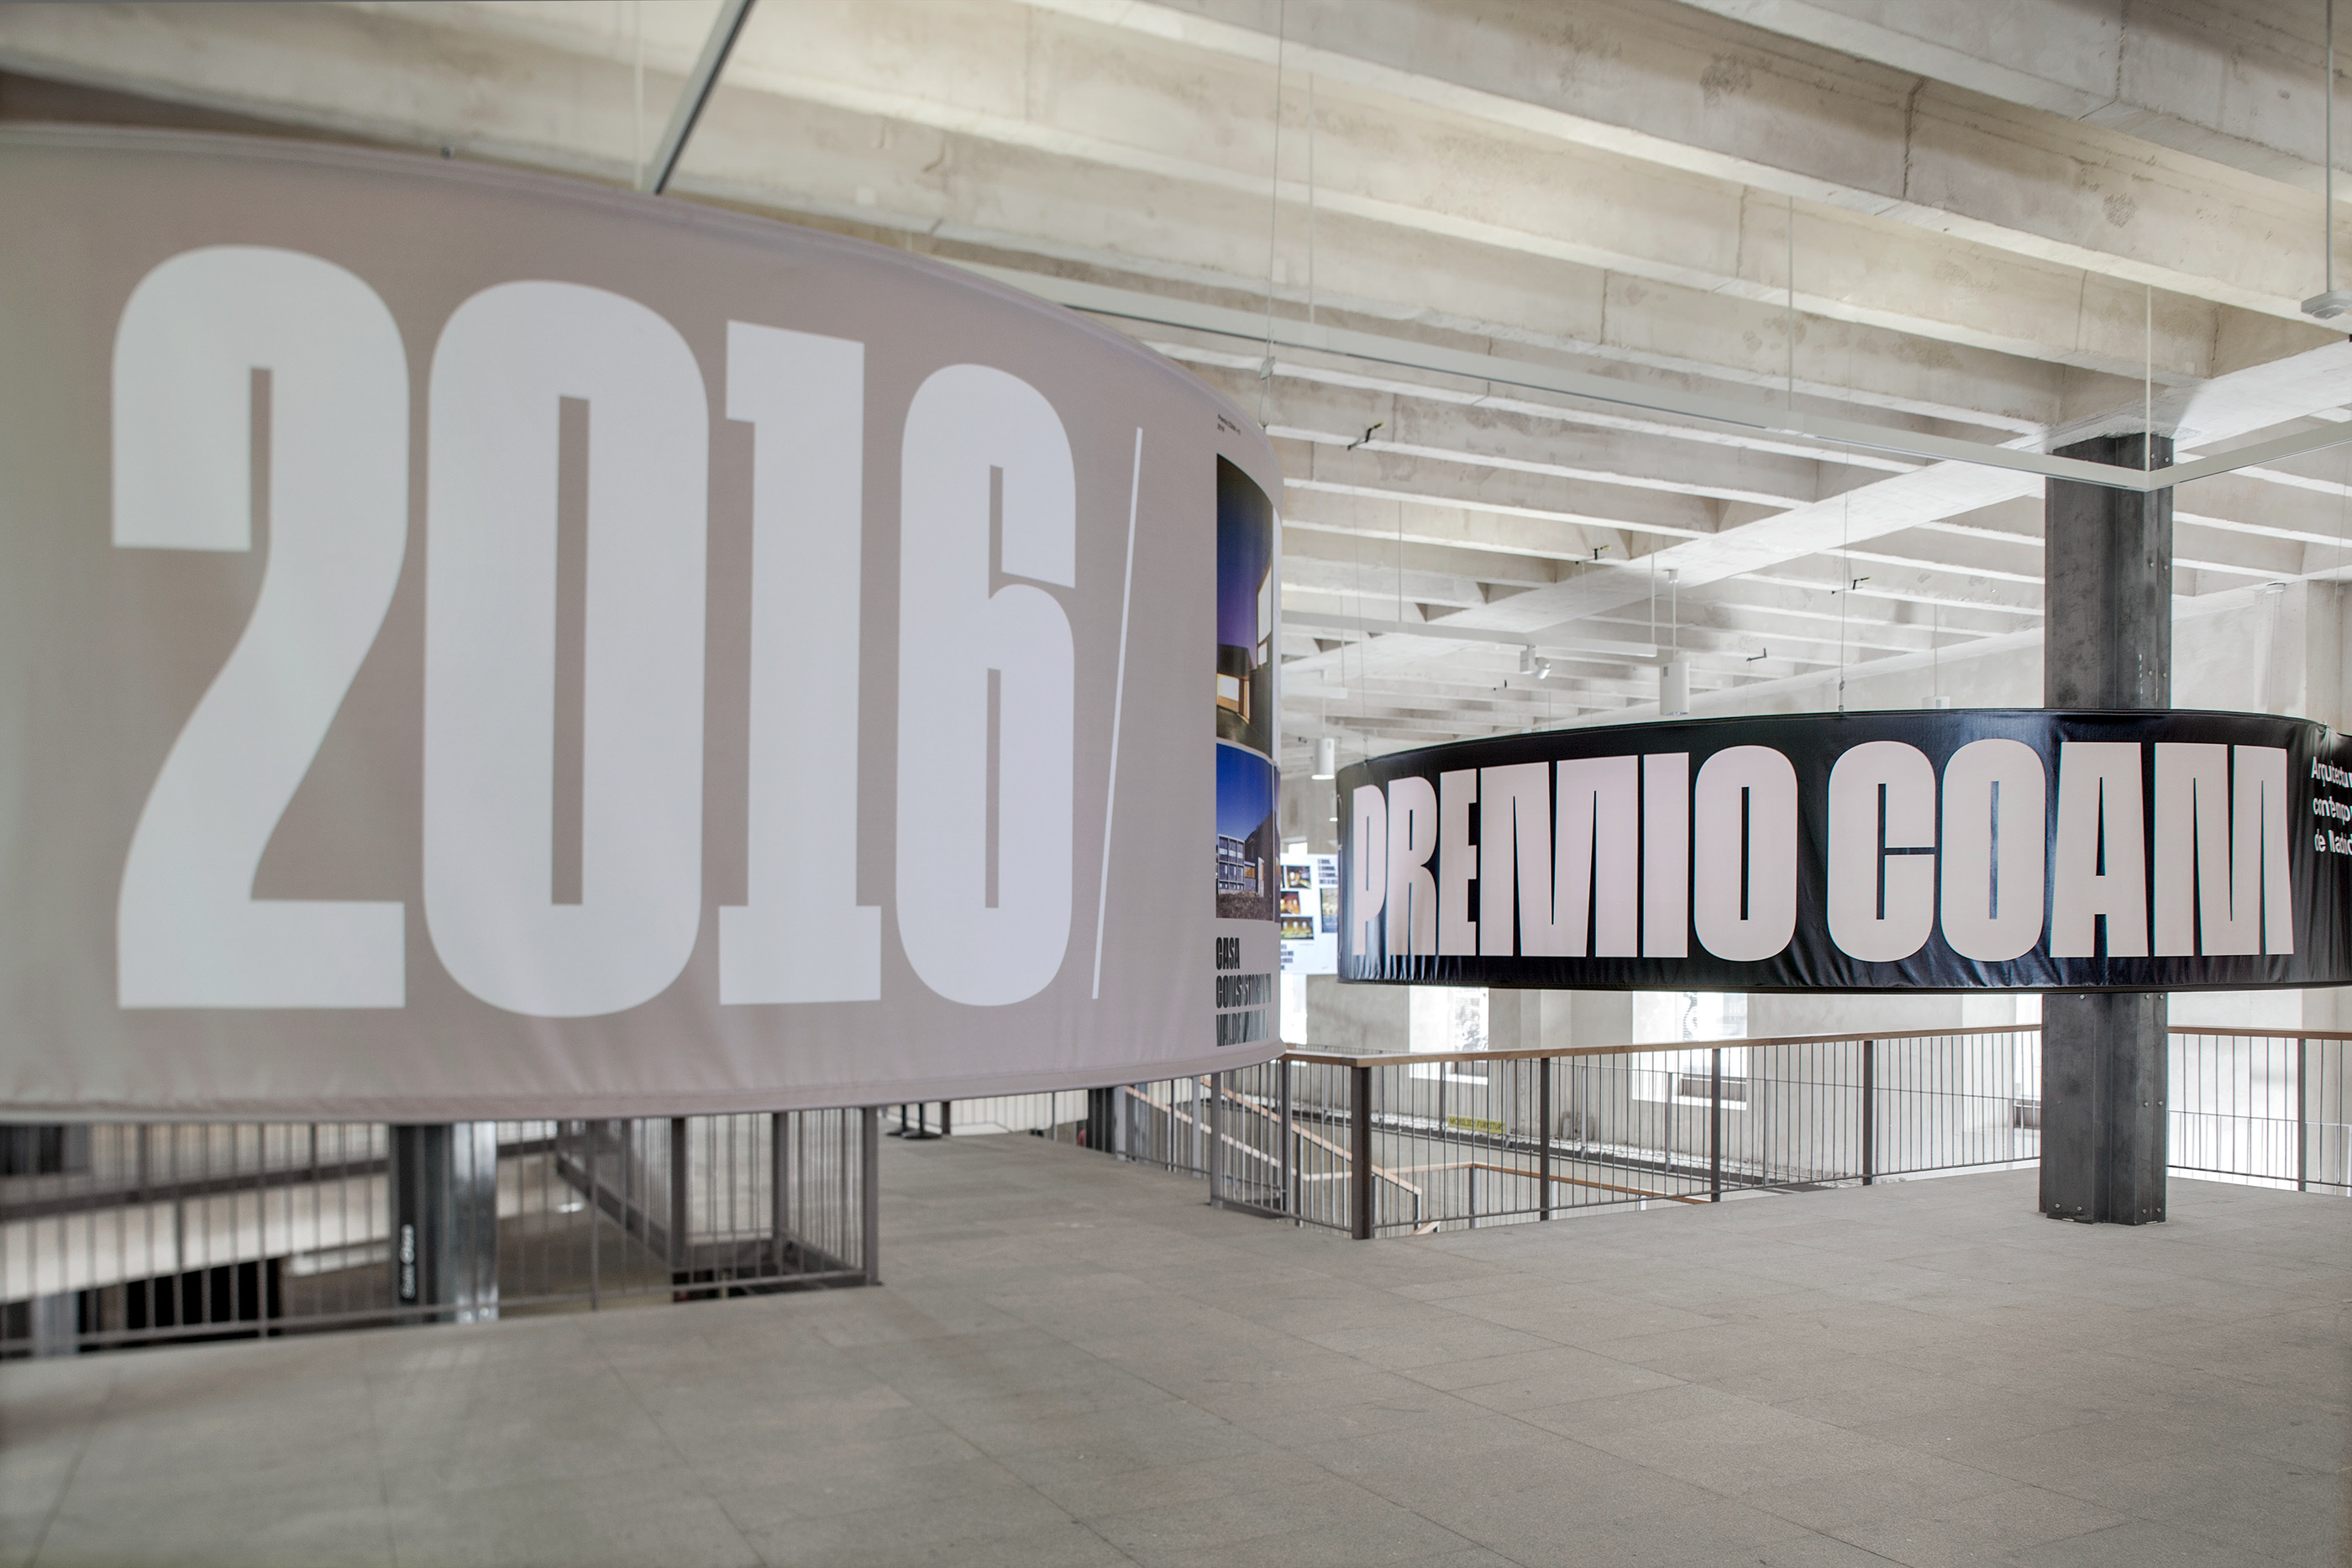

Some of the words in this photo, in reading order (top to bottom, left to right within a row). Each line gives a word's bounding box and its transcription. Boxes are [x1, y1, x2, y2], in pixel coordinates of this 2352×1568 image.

[1352, 744, 1798, 962] PREMIO
[1826, 738, 2295, 962] COAM
[2314, 828, 2327, 852] de
[1215, 936, 1241, 970] CASA
